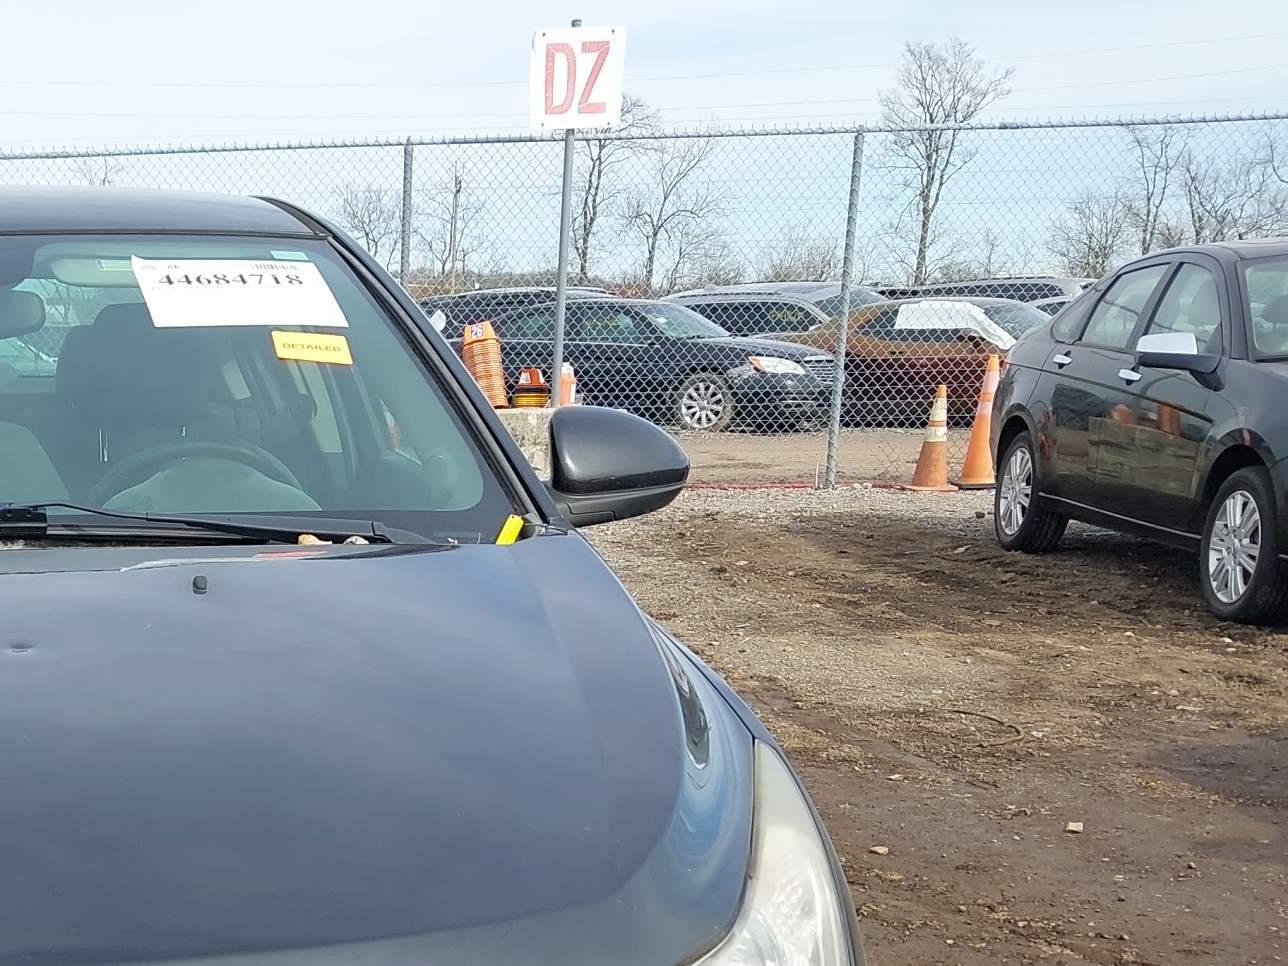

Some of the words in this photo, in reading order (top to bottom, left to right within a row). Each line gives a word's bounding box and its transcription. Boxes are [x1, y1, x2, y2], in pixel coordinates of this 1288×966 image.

[544, 40, 611, 115] DZ
[158, 272, 305, 287] 44684718
[471, 325, 484, 338] 26
[282, 342, 343, 353] DETAILED
